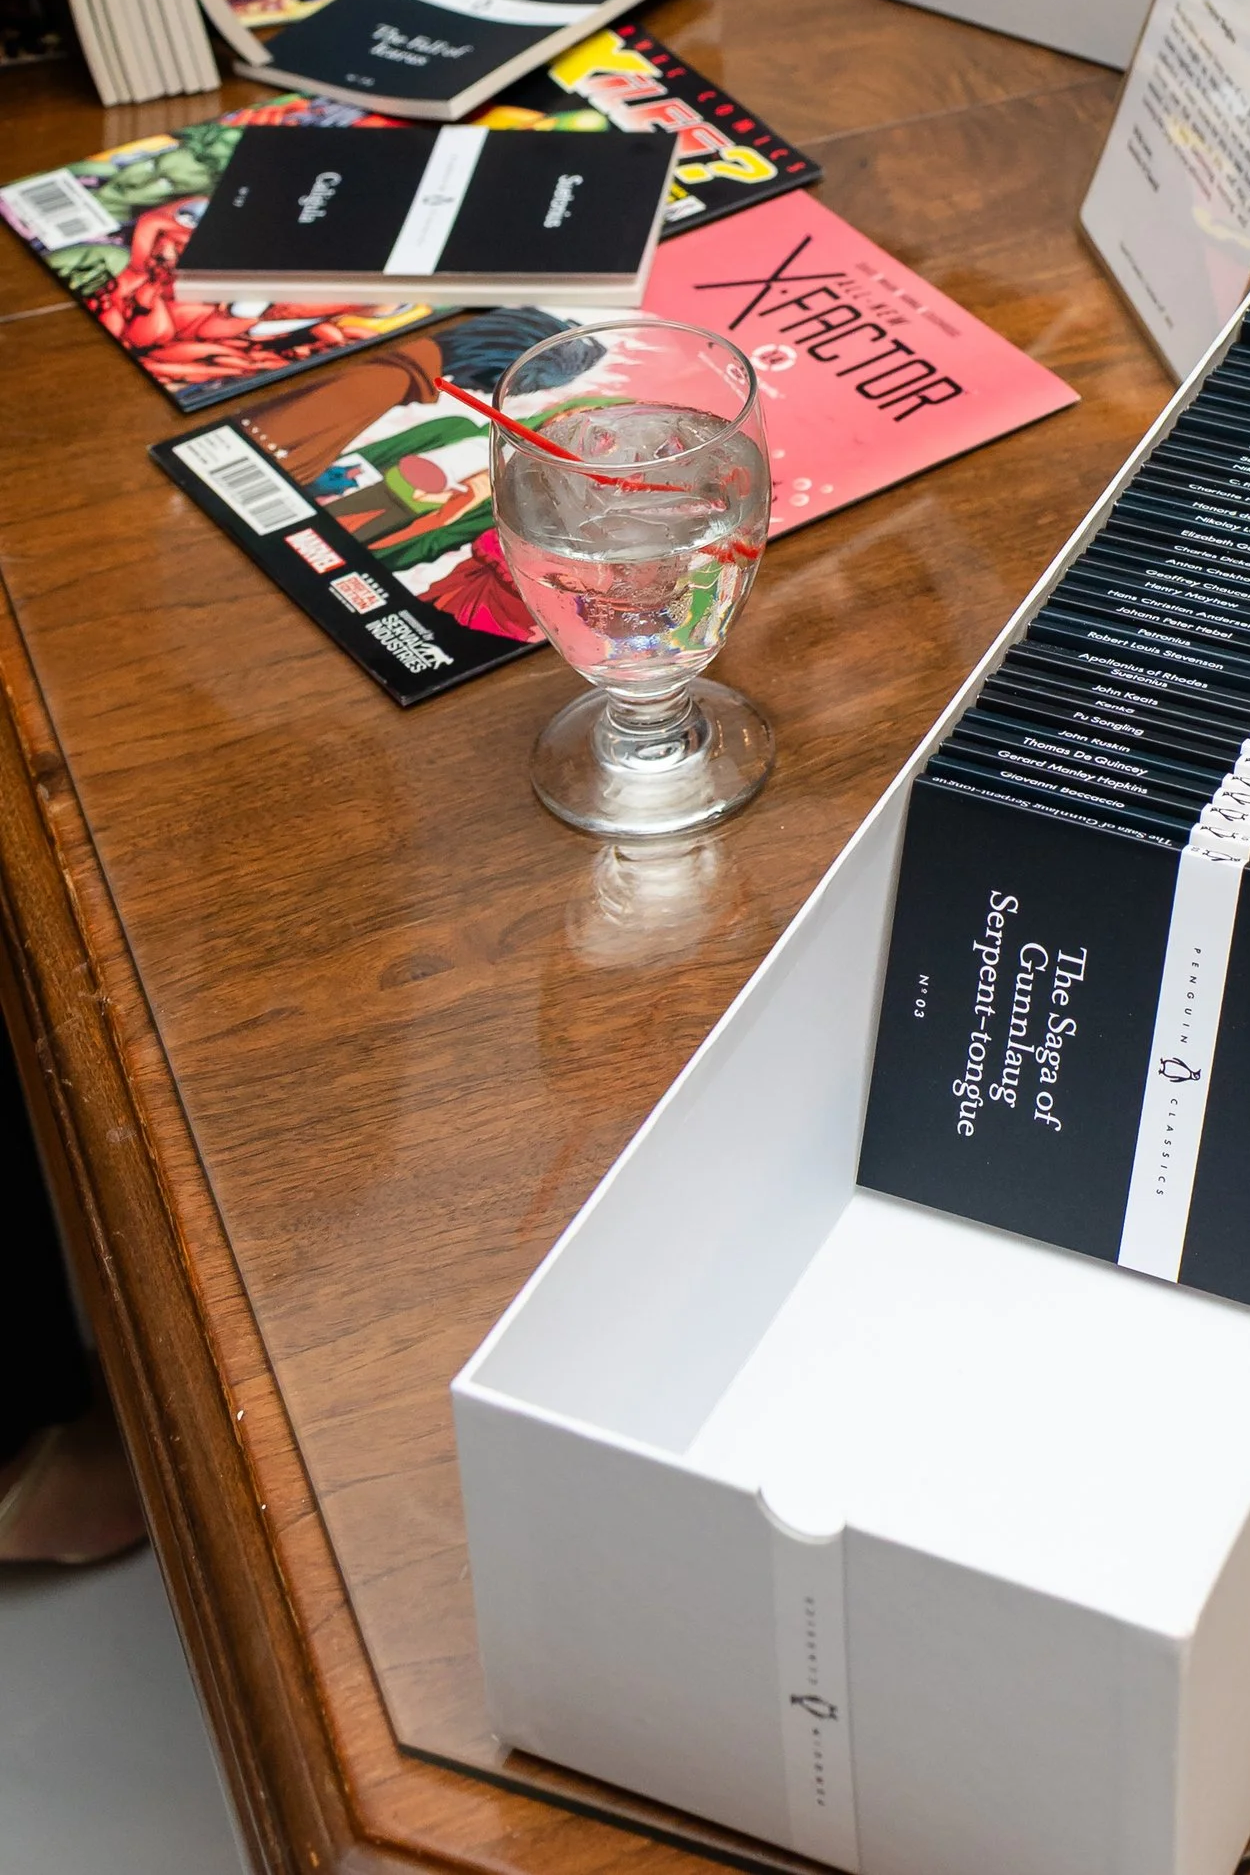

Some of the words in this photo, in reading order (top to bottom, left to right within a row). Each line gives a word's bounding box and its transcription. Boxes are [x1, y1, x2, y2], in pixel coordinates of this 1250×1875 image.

[698, 91, 806, 173] COMICS
[298, 172, 342, 223] Caligula
[543, 174, 583, 228] Suetonius
[836, 281, 911, 326] ALL-NEW
[285, 529, 343, 574] MARVEL
[365, 620, 427, 673] INDUSTRIES
[382, 614, 424, 651] SERVAL
[1087, 631, 1128, 648] Robert
[1130, 643, 1159, 655] Louis
[1163, 649, 1224, 670] Stevenson
[1073, 711, 1088, 721] Pu
[1091, 715, 1144, 737] Songling
[997, 750, 1046, 768] Gerard
[1048, 762, 1096, 782] Manley
[1097, 775, 1148, 795] Hopkins
[1023, 736, 1070, 756] Thomas
[1074, 750, 1092, 761] De
[1095, 756, 1148, 776] Quincey
[999, 770, 1058, 792] Giovanni
[1060, 787, 1125, 809] Boccaccio
[1052, 947, 1087, 1006] The
[1180, 947, 1202, 1044] PENGUIN
[914, 999, 926, 1018] 03
[952, 889, 1019, 1137] Serpent-tongue
[989, 942, 1049, 1108] Gunnlaug
[1035, 1012, 1077, 1084] Saga
[1034, 1091, 1062, 1132] of
[1156, 1097, 1178, 1195] CLASSICS
